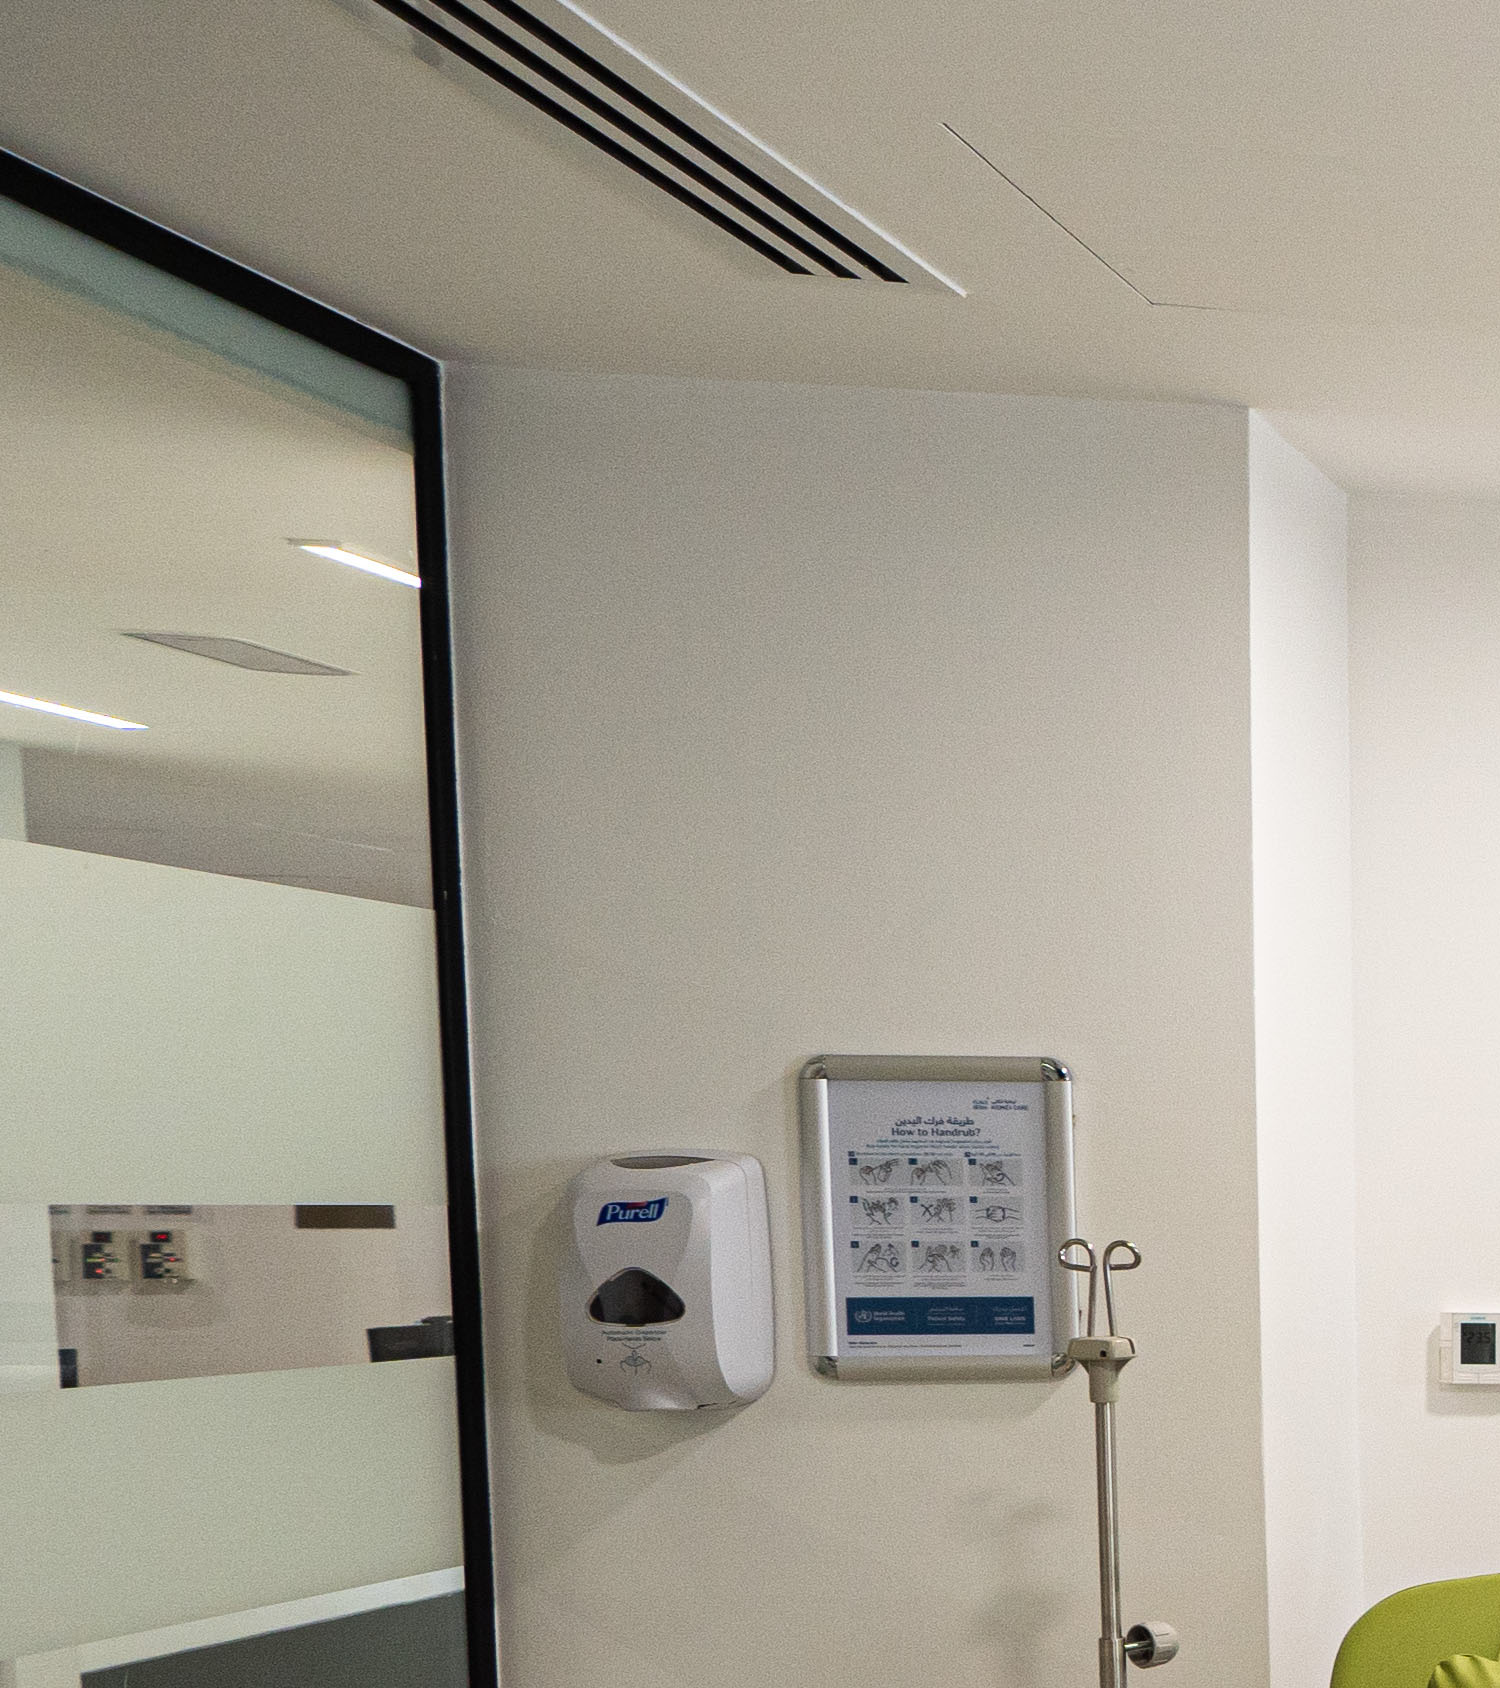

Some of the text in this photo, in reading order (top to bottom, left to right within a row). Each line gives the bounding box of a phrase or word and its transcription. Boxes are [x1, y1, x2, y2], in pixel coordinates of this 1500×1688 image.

[891, 1127, 981, 1137] How to Handrub?
[605, 1203, 660, 1221] Purell
